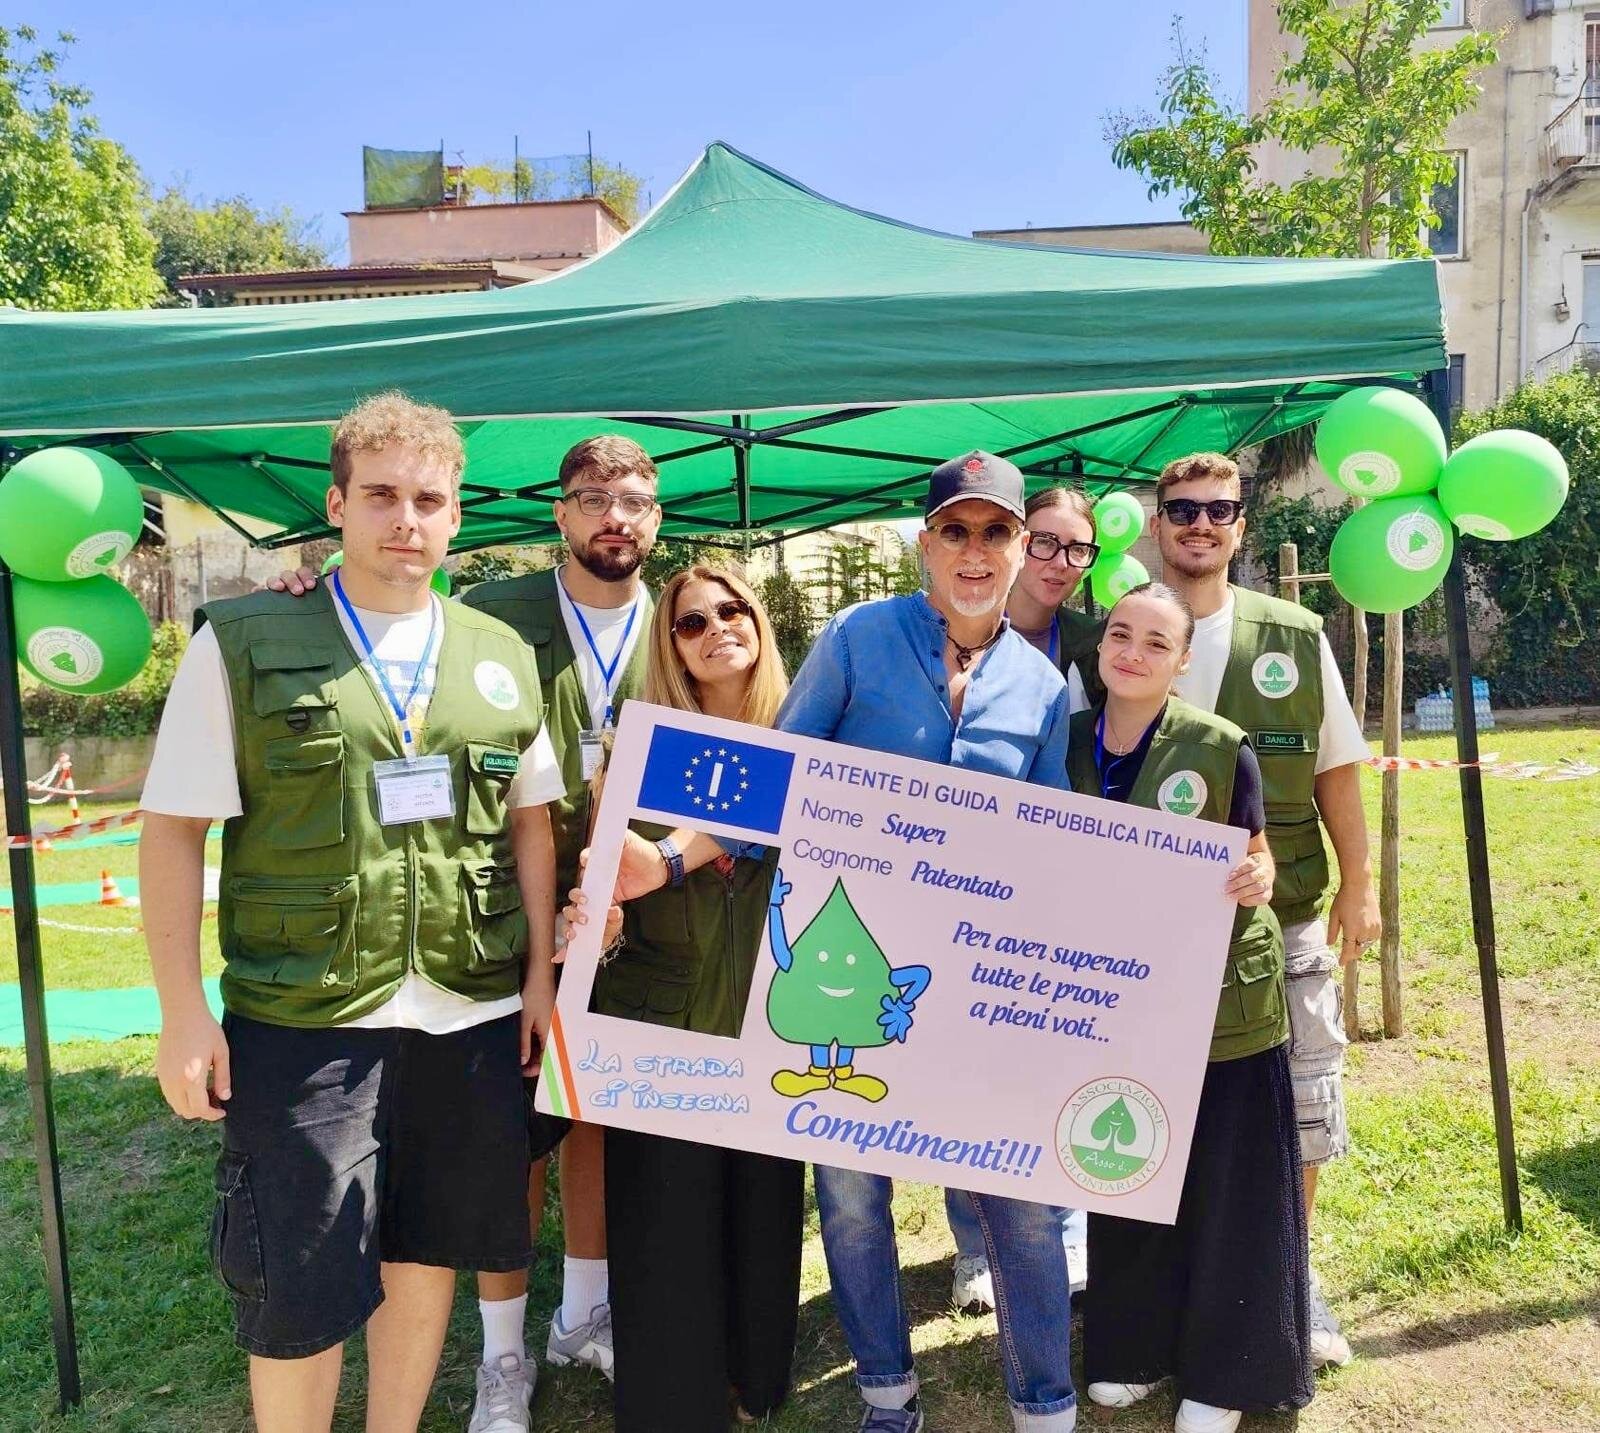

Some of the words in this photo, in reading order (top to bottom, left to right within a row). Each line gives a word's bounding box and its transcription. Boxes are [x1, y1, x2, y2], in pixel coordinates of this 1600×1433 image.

[1264, 735, 1296, 745] DANILO
[800, 798, 863, 828] Nome
[881, 813, 947, 845] Super
[806, 757, 903, 793] PATENTE
[908, 779, 929, 799] DI
[935, 785, 999, 814] GUIDA
[1016, 802, 1138, 844] REPUBBLICA
[1144, 829, 1230, 864] ITALIANA
[793, 838, 893, 875] Cognome
[910, 860, 1014, 901] Patentato
[952, 921, 992, 949] Per
[994, 936, 1048, 960] aver
[1050, 946, 1151, 980] superato
[971, 962, 1026, 991] tutte
[1028, 972, 1052, 996] le
[1051, 981, 1120, 1009] prove
[969, 1001, 987, 1019] a
[988, 1001, 1051, 1030] pieni
[1052, 1016, 1110, 1043] voti...
[1070, 1081, 1165, 1130] ASSOCIAZIONE
[785, 1100, 1042, 1178] Complimenti!!!
[1081, 1151, 1116, 1170] Asso
[1060, 1143, 1157, 1193] VOLONTARIATO
